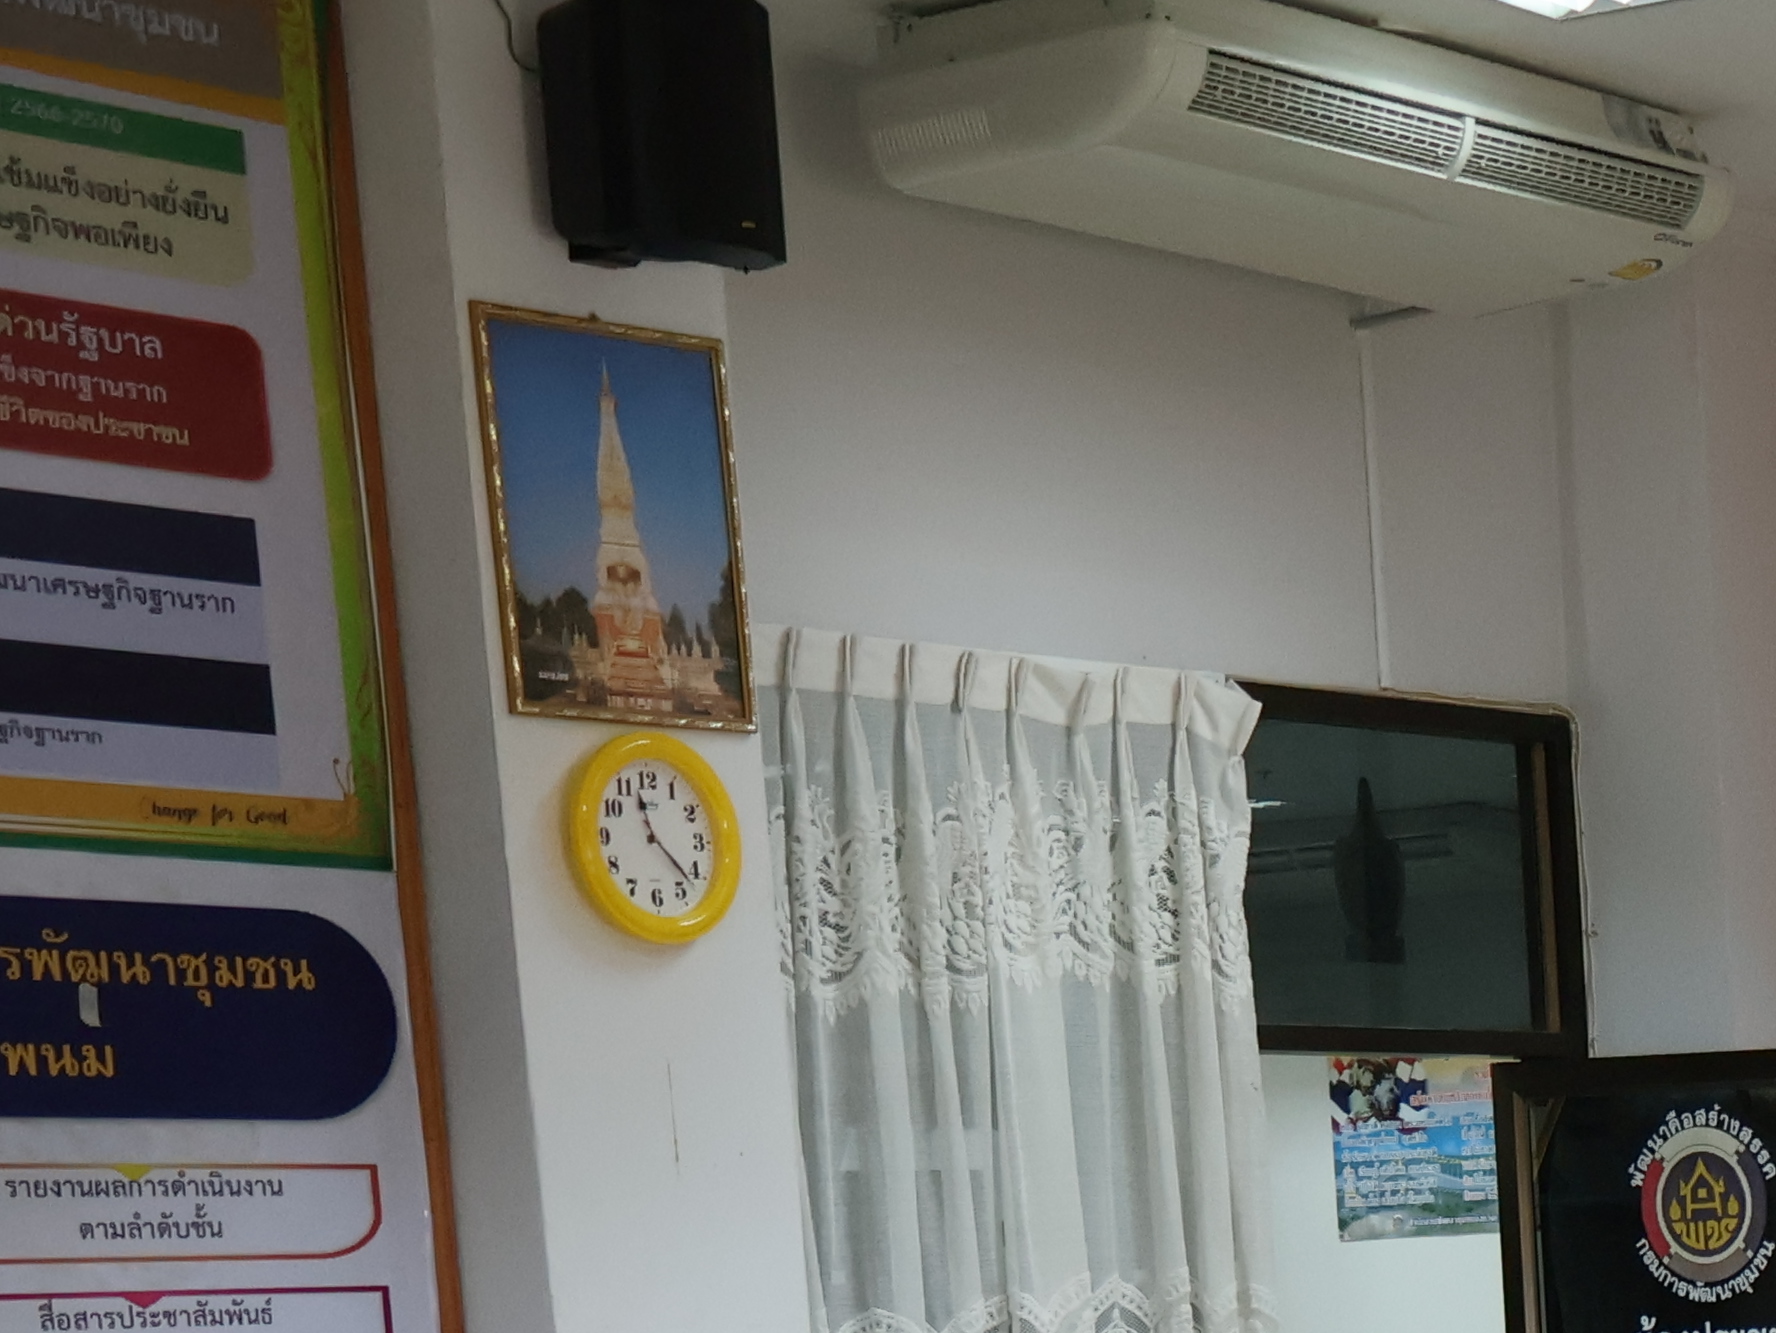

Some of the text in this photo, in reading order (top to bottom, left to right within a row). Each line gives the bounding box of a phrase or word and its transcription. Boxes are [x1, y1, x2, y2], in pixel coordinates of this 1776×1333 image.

[615, 776, 633, 797] 11
[637, 770, 658, 790] 12
[667, 779, 676, 801] 1
[604, 797, 623, 818] 10
[682, 804, 697, 824] 2
[599, 826, 611, 846] 9
[692, 832, 706, 853] 3
[607, 855, 620, 875] 8
[688, 860, 701, 880] 4
[625, 877, 638, 898] 7
[650, 888, 664, 908] 6
[674, 881, 687, 901] 5
[4, 1171, 284, 1199] รายงานผลการดำเนินงาน
[78, 1203, 224, 1241] ตามลำดับชั้น
[38, 1297, 274, 1332] สื่อสารประชาสัมพันธ์
